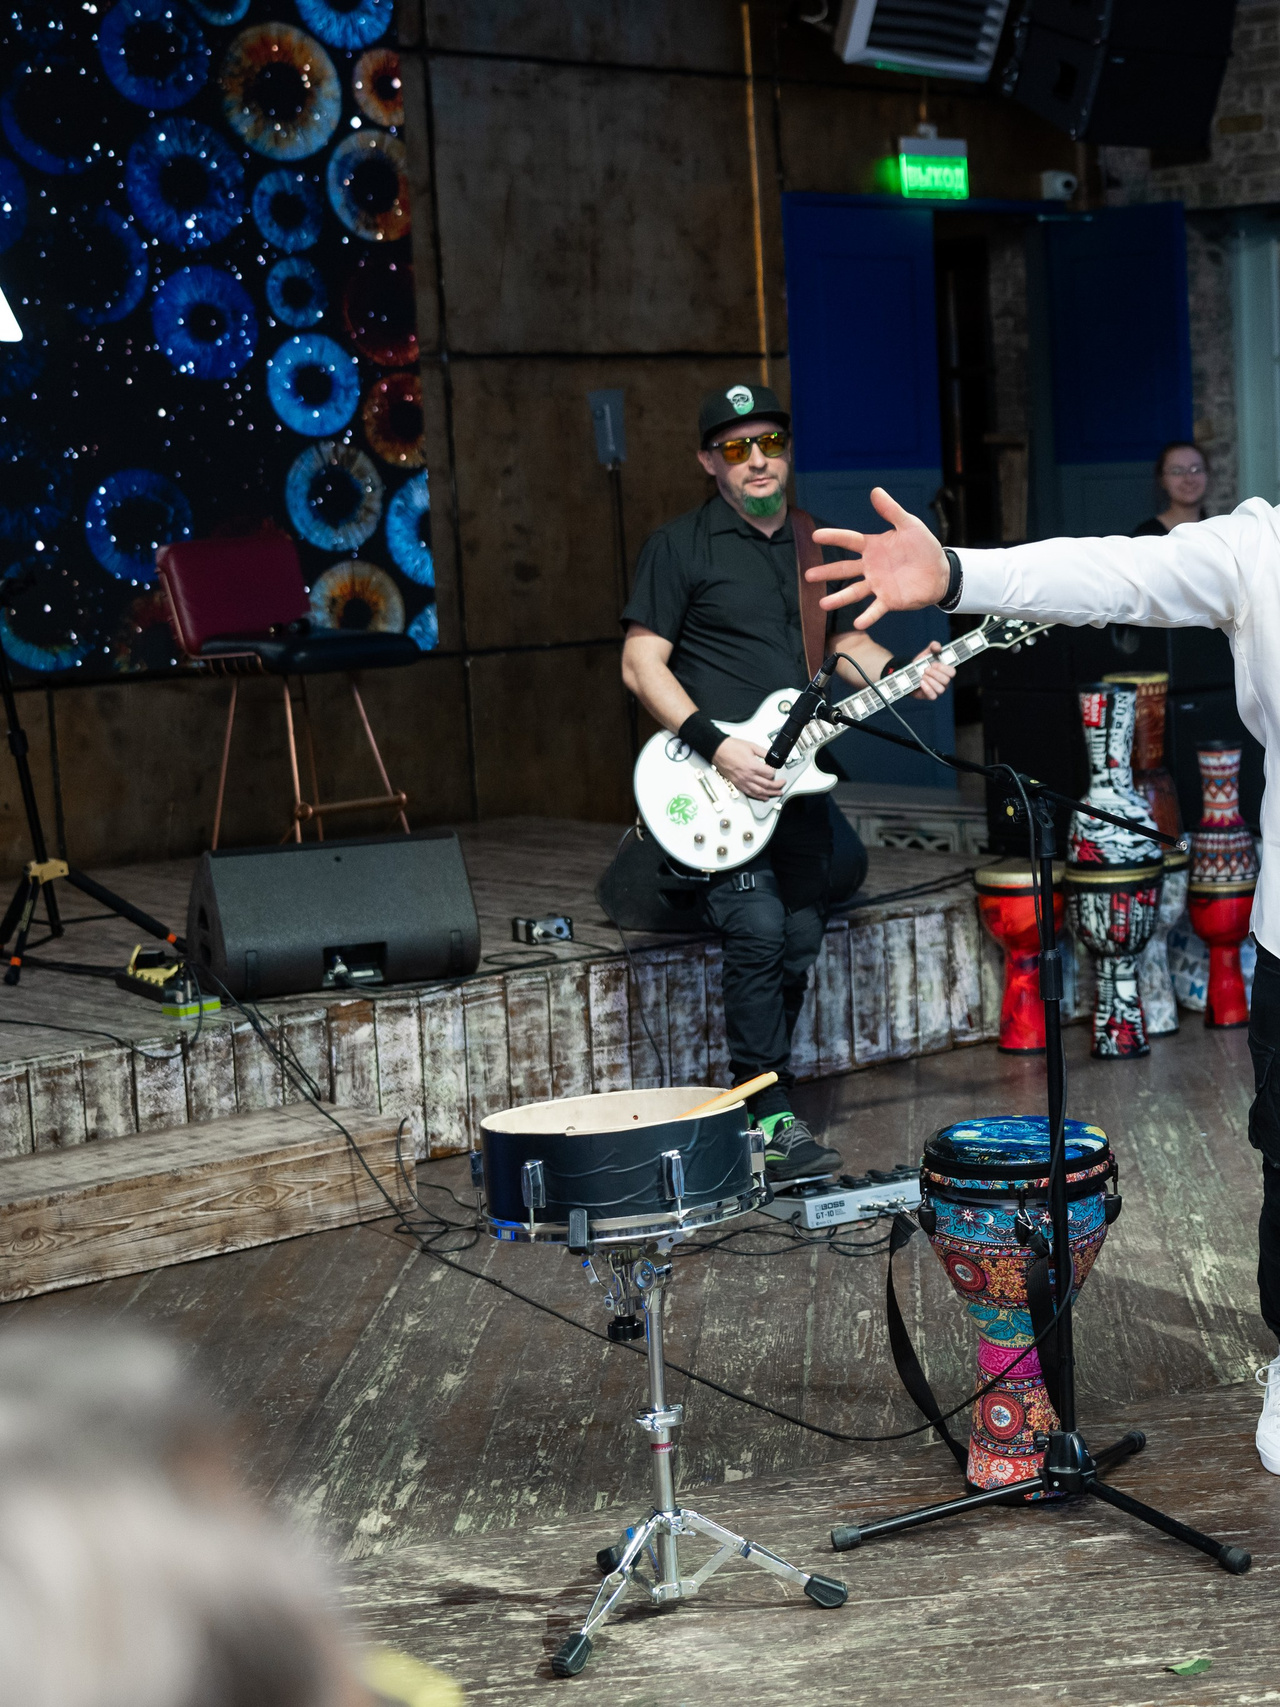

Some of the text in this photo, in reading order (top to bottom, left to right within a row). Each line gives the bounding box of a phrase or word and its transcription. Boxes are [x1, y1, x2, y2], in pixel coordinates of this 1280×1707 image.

[907, 164, 967, 196] ВЫХОД
[821, 1200, 845, 1211] BOSS
[815, 1209, 835, 1220] GT-10
